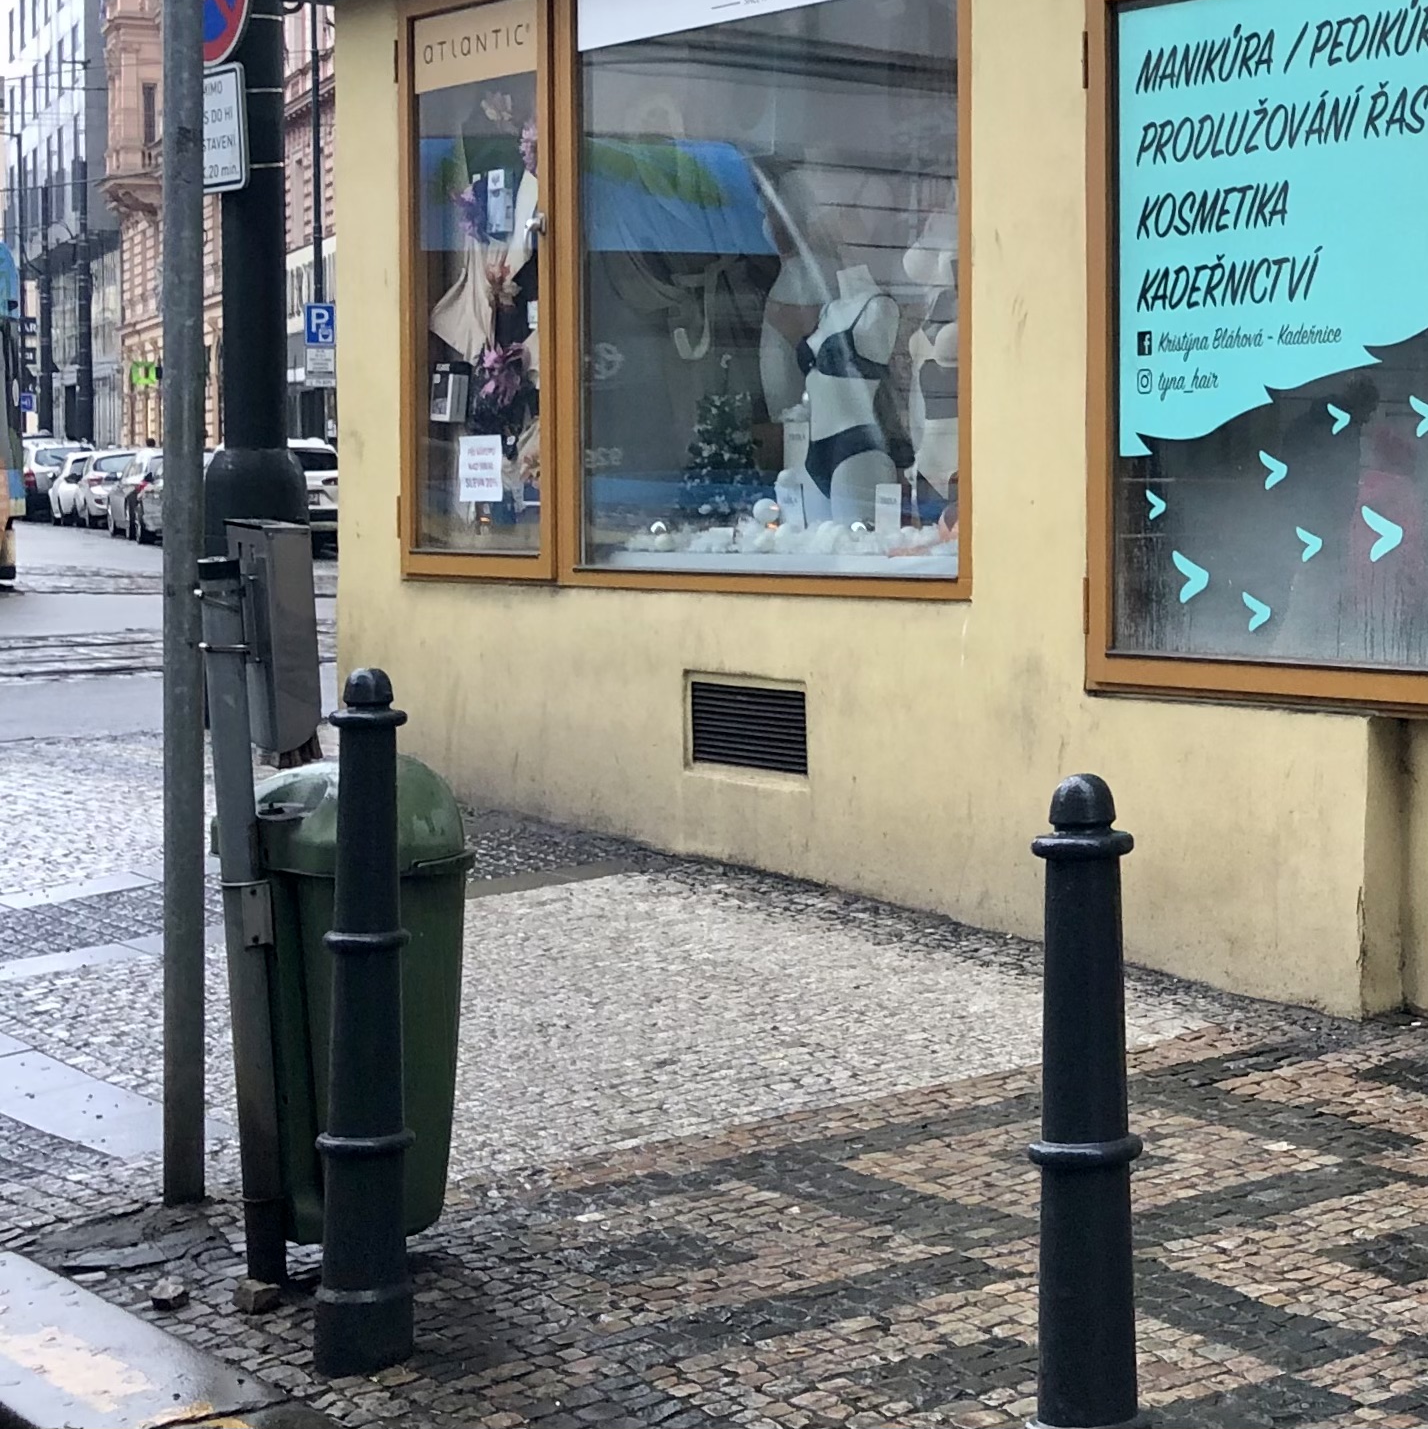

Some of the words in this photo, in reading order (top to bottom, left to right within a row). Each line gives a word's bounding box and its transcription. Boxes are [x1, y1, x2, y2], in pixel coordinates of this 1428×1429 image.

[1135, 23, 1275, 94] MANIKÚRA
[1136, 85, 1364, 167] PRODLUŽOVÁNÍ
[1136, 180, 1290, 240] KOSMETIKA
[1136, 245, 1324, 313] KADEŘNICTVÍ
[1158, 331, 1210, 362] Kristýna
[1212, 326, 1264, 350] Bláhová
[1277, 322, 1342, 346] Kadeřnice
